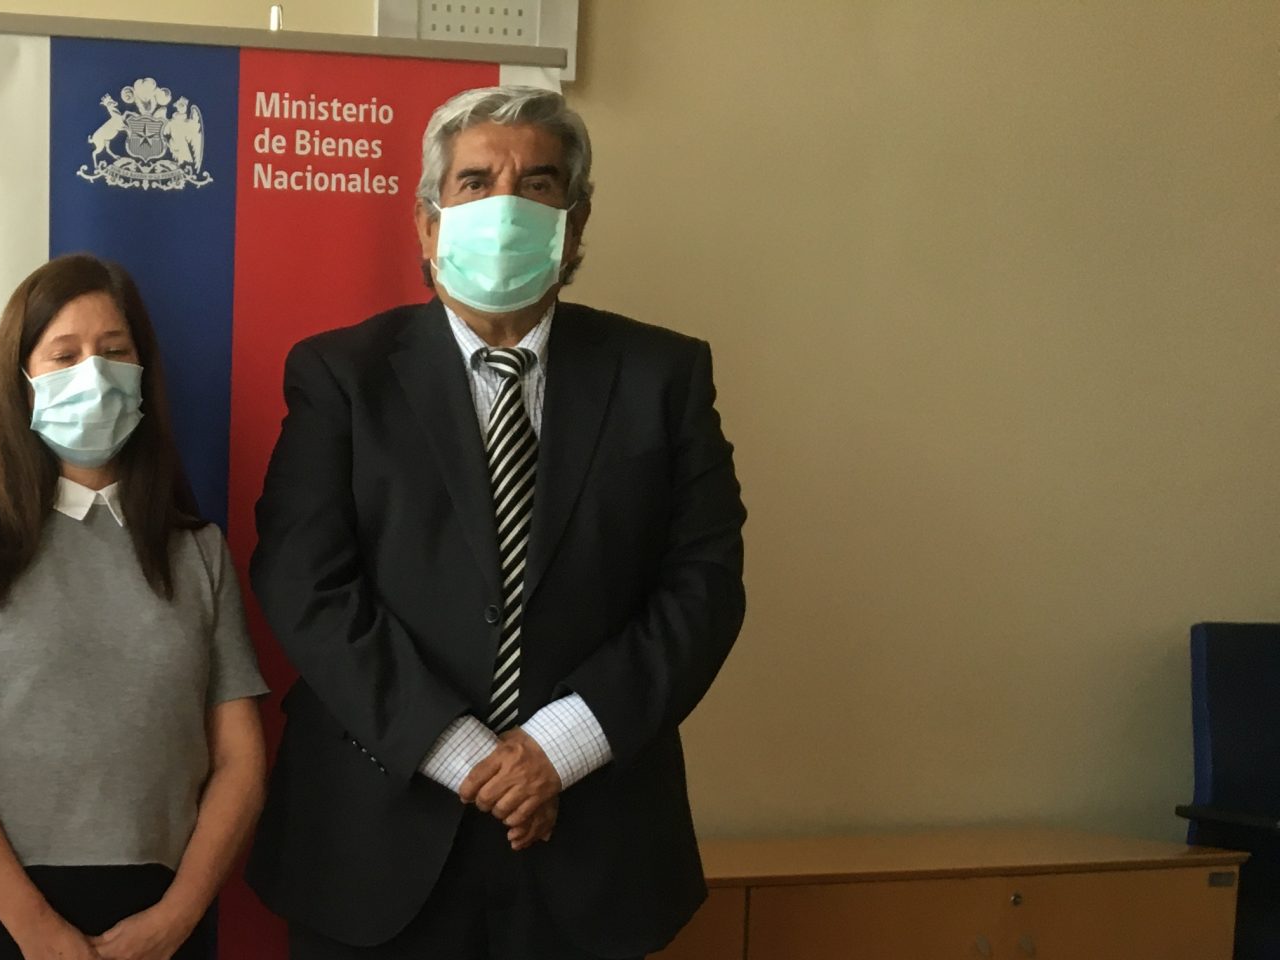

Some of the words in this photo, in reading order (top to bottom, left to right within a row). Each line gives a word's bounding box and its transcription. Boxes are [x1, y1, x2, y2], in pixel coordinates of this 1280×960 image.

[255, 91, 394, 125] Ministerio
[253, 127, 287, 154] de
[295, 129, 383, 159] Bienes
[253, 163, 400, 195] Nacionales
